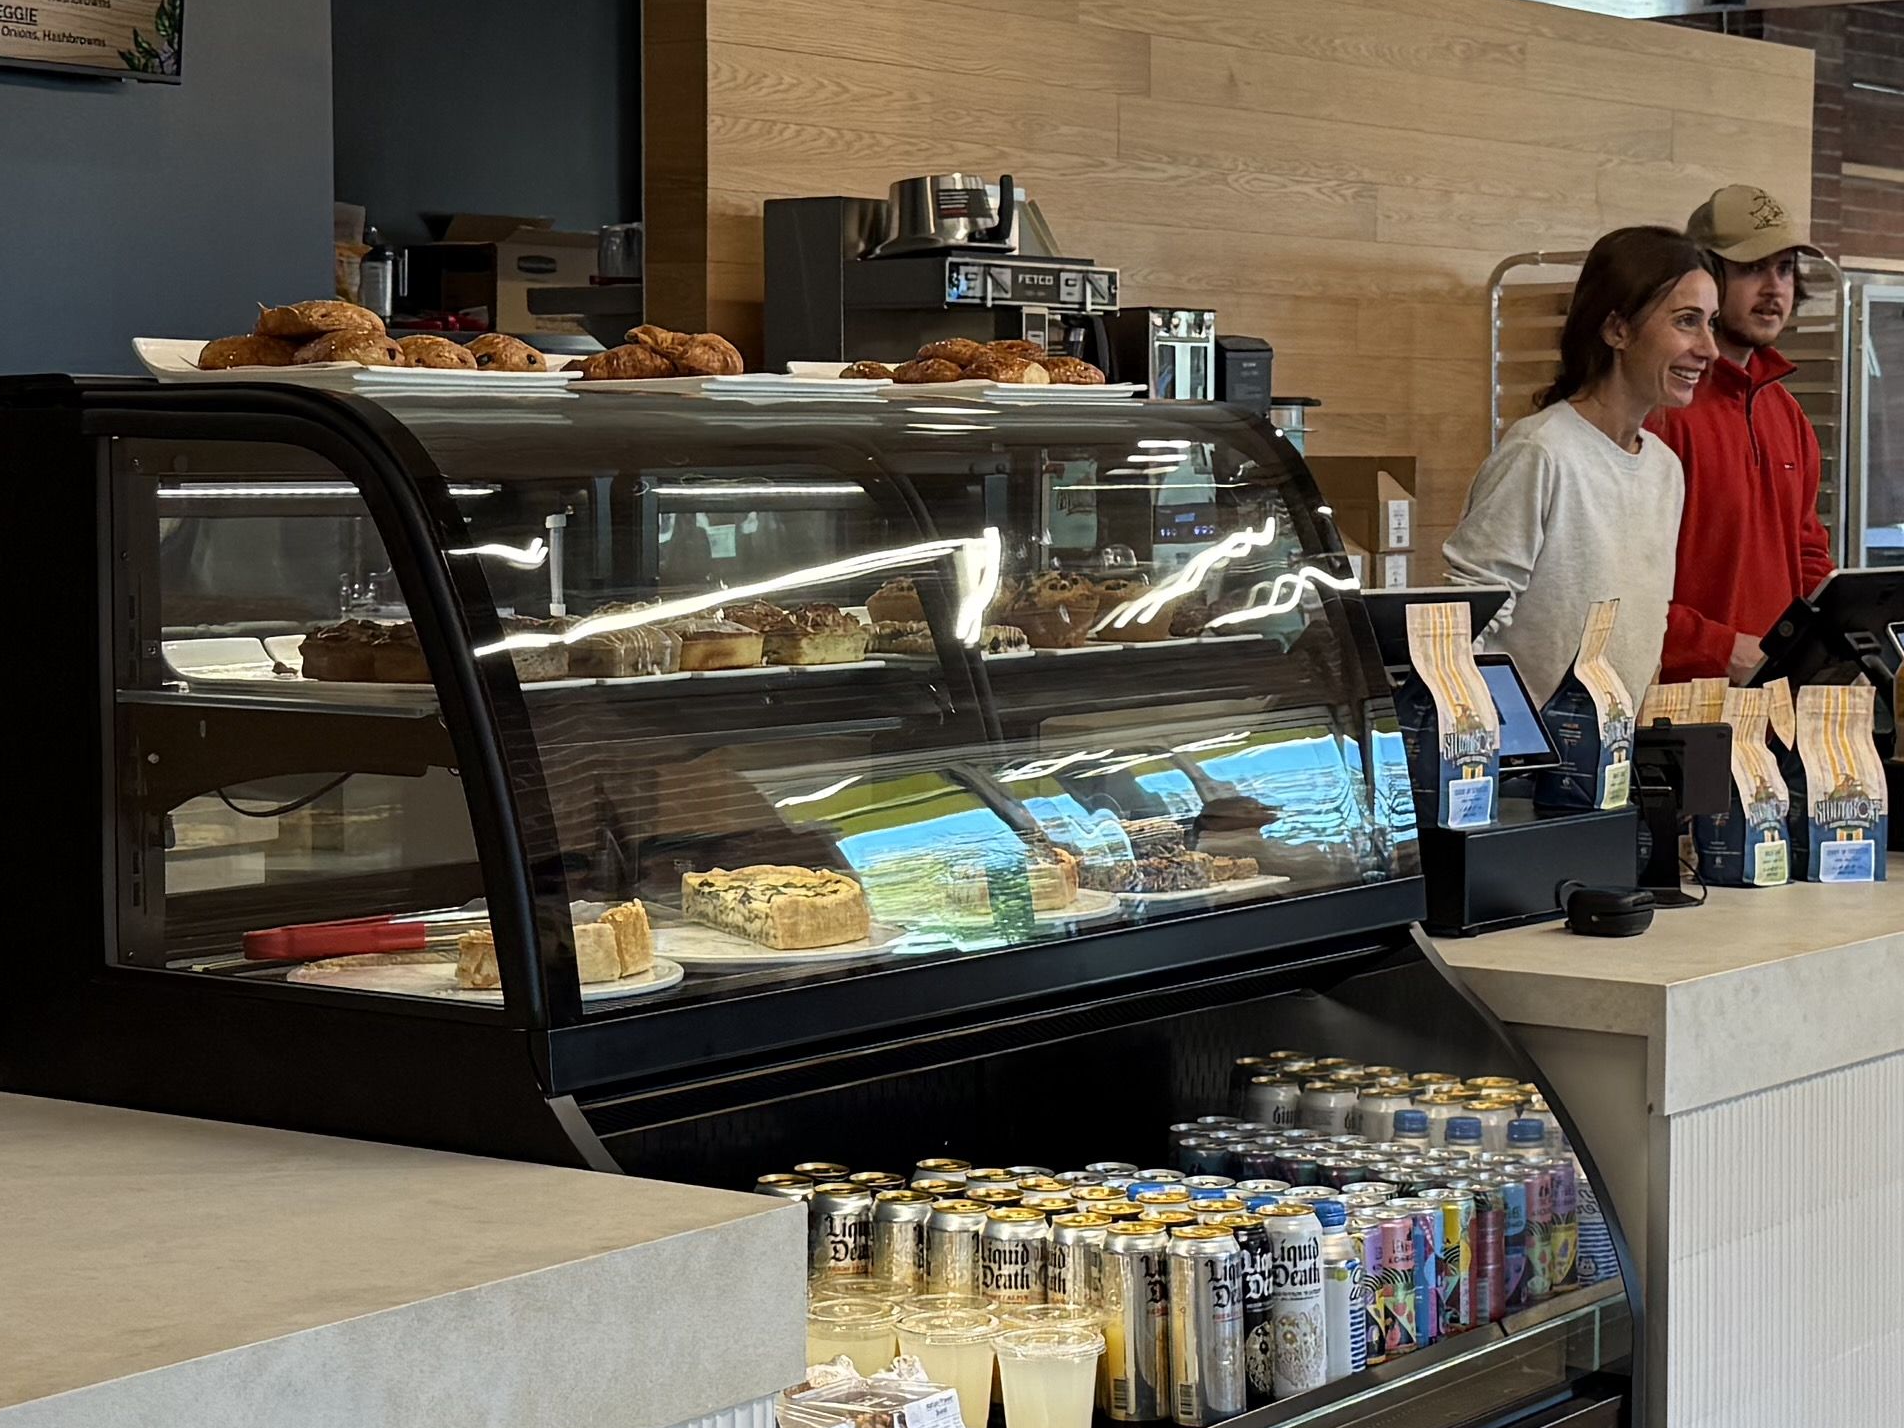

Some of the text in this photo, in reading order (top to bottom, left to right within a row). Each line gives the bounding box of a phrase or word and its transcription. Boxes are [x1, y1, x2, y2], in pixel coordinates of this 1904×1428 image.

[1018, 274, 1054, 286] FETCO
[824, 1213, 873, 1245] Liqu
[831, 1239, 873, 1262] Dea
[981, 1239, 1030, 1270] Liquid
[982, 1264, 1030, 1290] Death
[1272, 1261, 1320, 1287] Death
